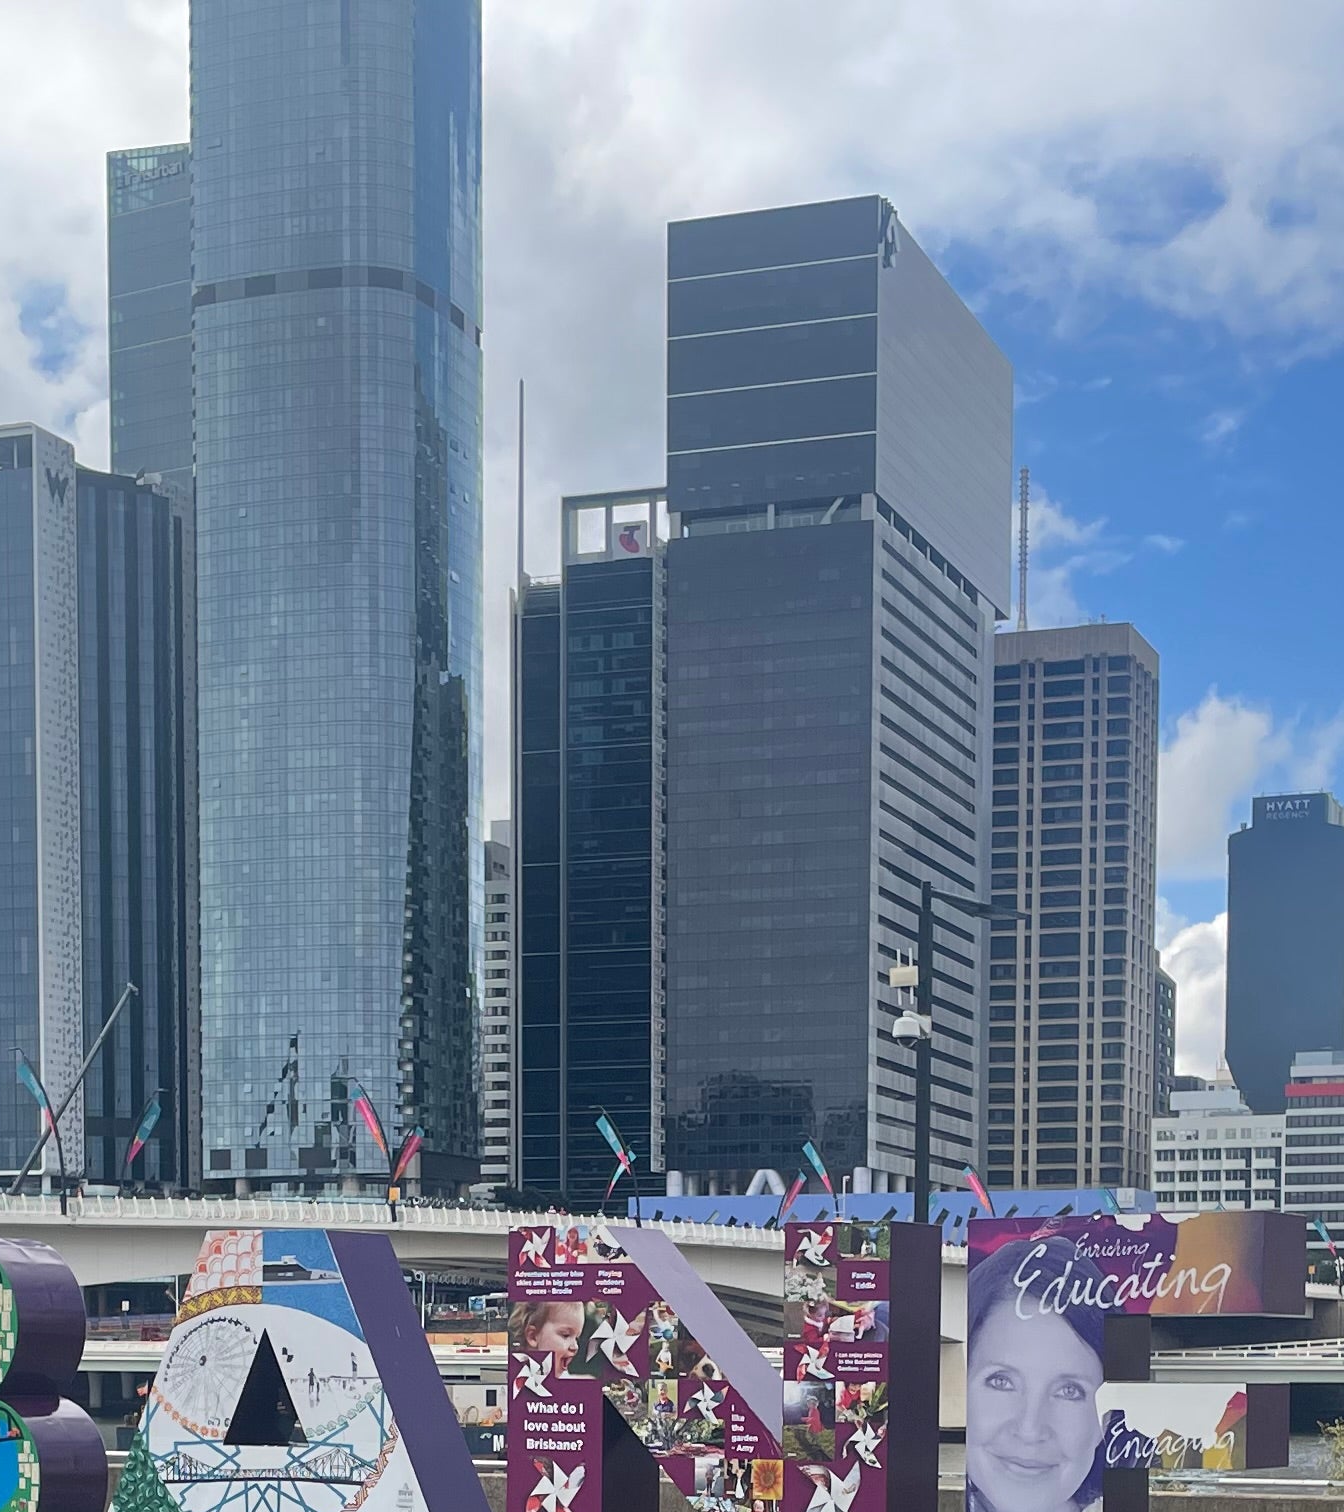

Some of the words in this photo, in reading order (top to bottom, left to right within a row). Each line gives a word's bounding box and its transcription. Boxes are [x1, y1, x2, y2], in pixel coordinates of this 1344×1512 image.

[45, 467, 69, 508] W
[1266, 799, 1311, 811] HYATT
[1074, 1232, 1150, 1273] Enriching
[851, 1271, 876, 1280] Family
[1013, 1243, 1232, 1320] Educating
[526, 1402, 558, 1415] What
[561, 1402, 576, 1415] do
[579, 1403, 584, 1415] I
[524, 1419, 548, 1432] love
[551, 1420, 586, 1433] about
[526, 1438, 584, 1451] Brisbane?
[731, 1434, 759, 1443] garden
